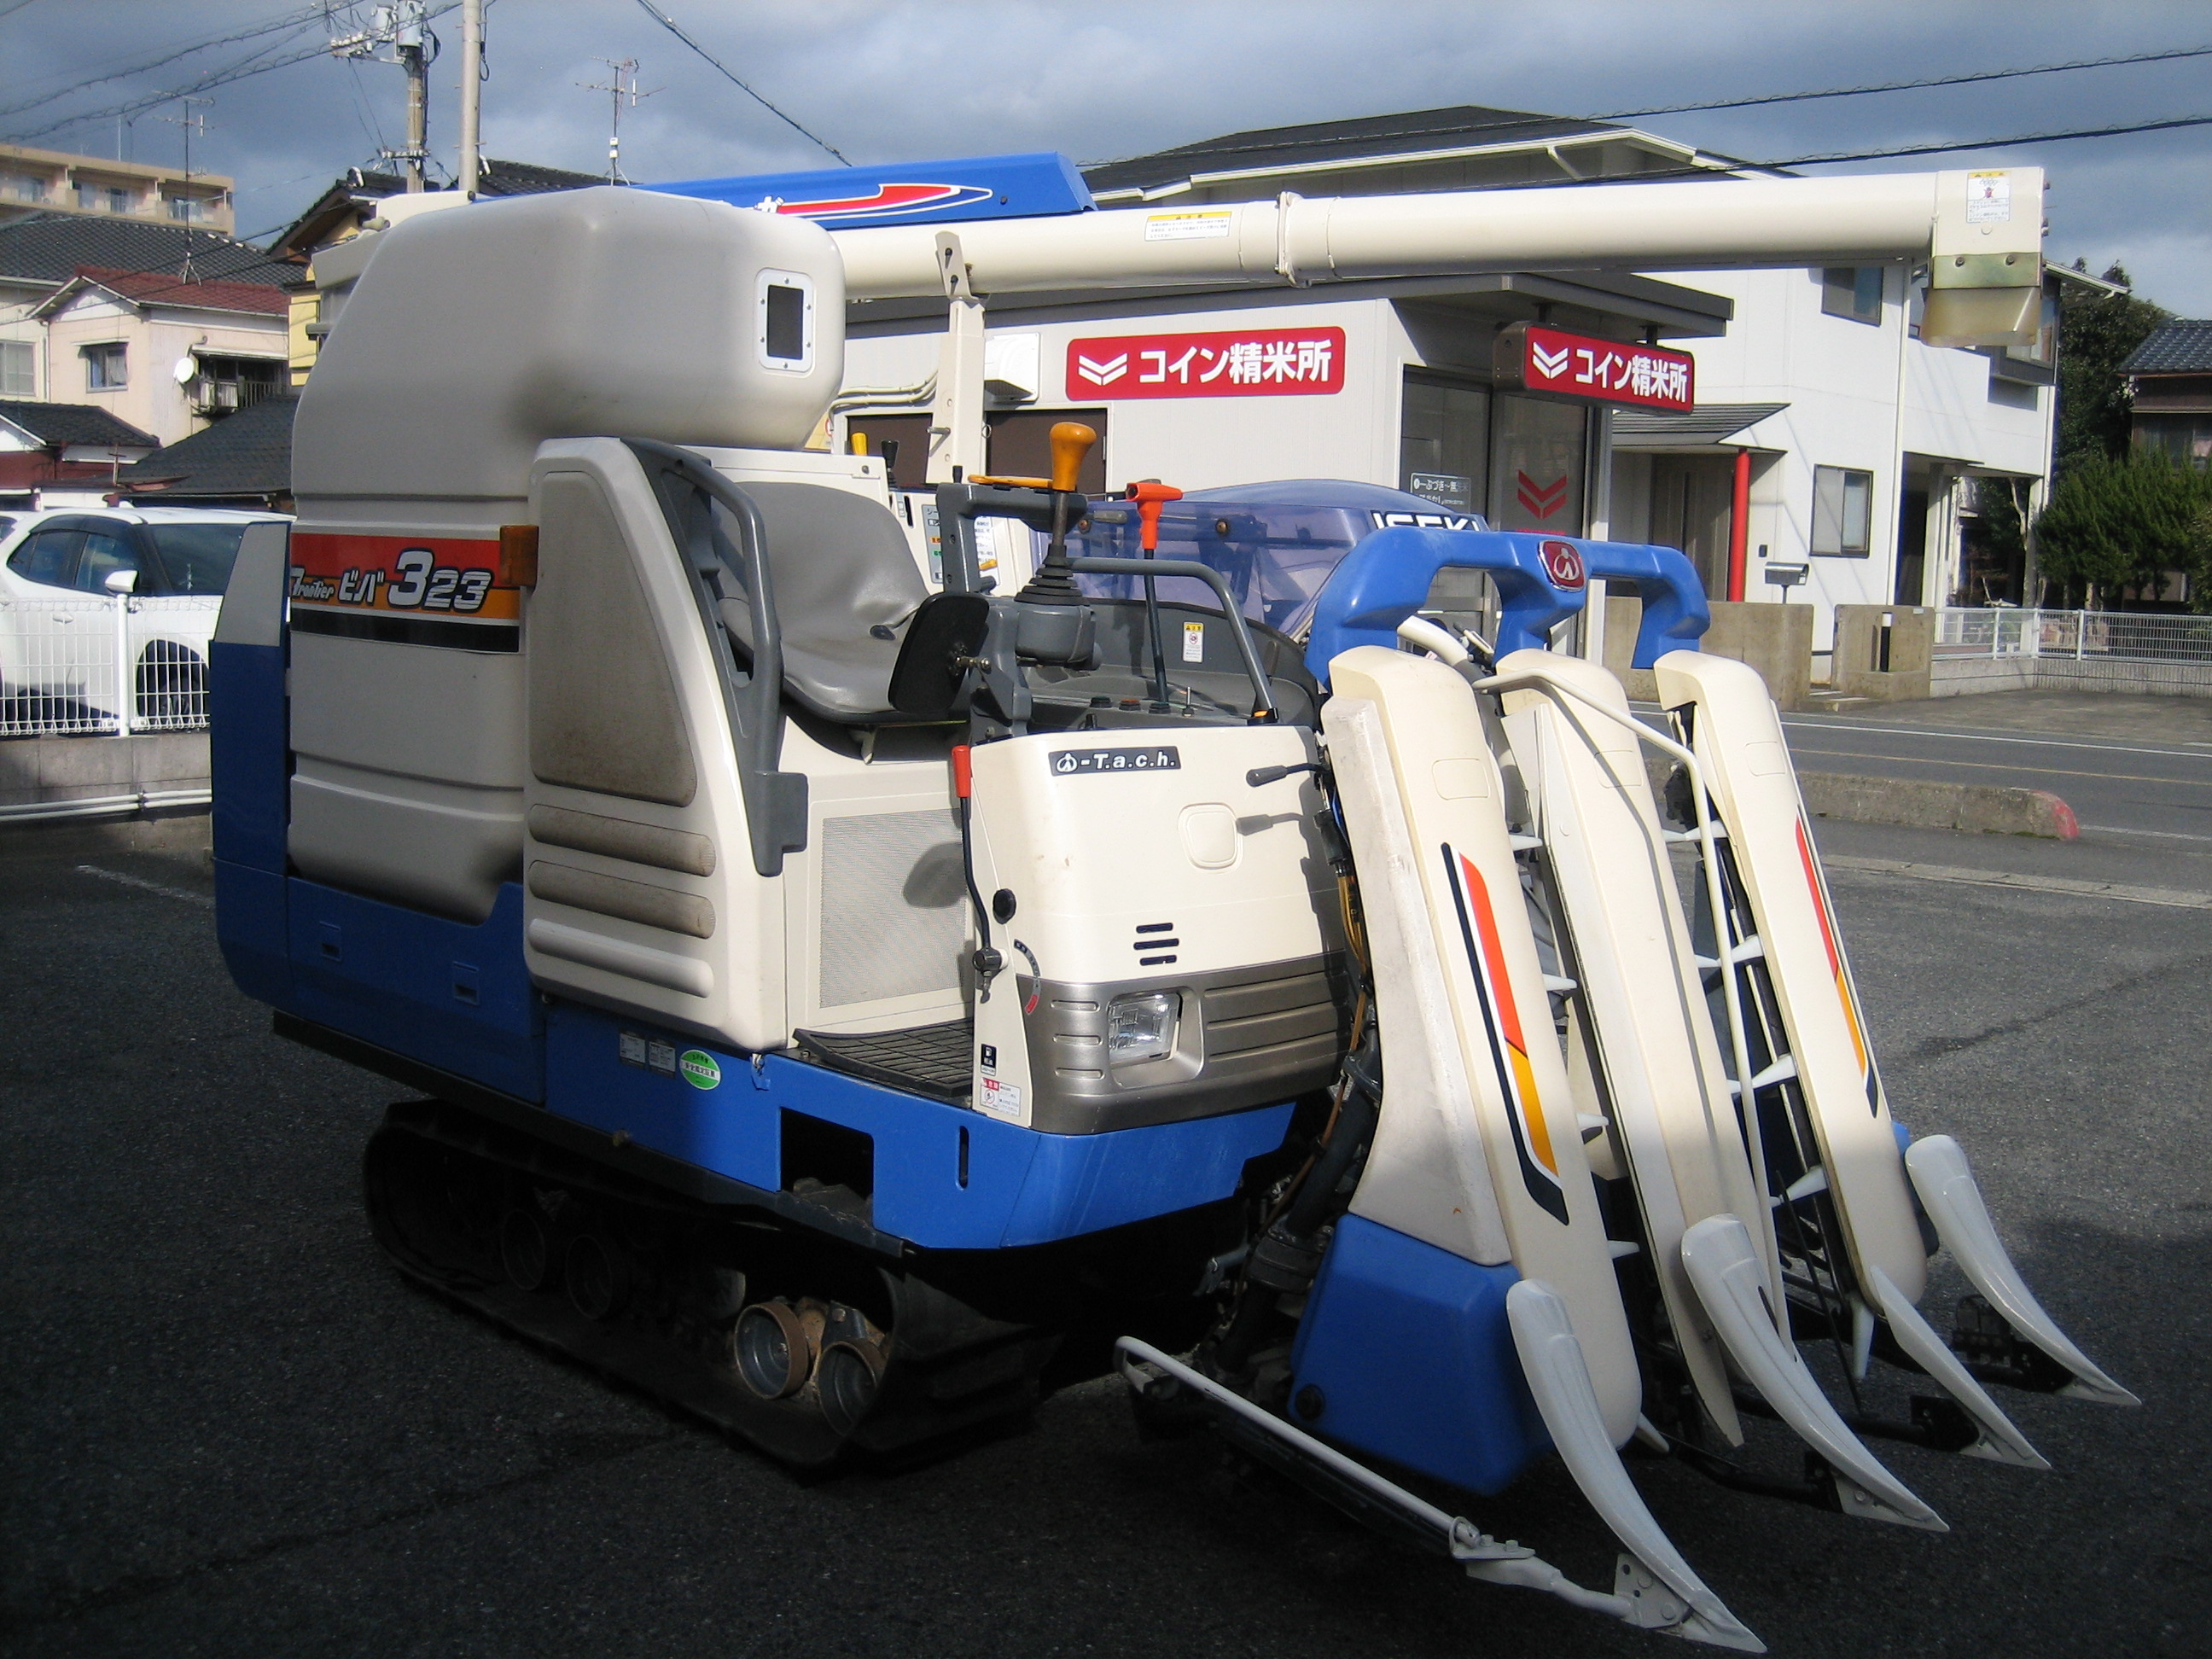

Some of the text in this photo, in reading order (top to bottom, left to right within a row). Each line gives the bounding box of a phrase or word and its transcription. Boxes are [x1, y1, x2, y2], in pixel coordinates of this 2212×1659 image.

[1139, 339, 1332, 384] コイン精米所
[1575, 347, 1688, 403] コイン精米所
[338, 568, 385, 603] ビバ
[388, 550, 492, 610] 323
